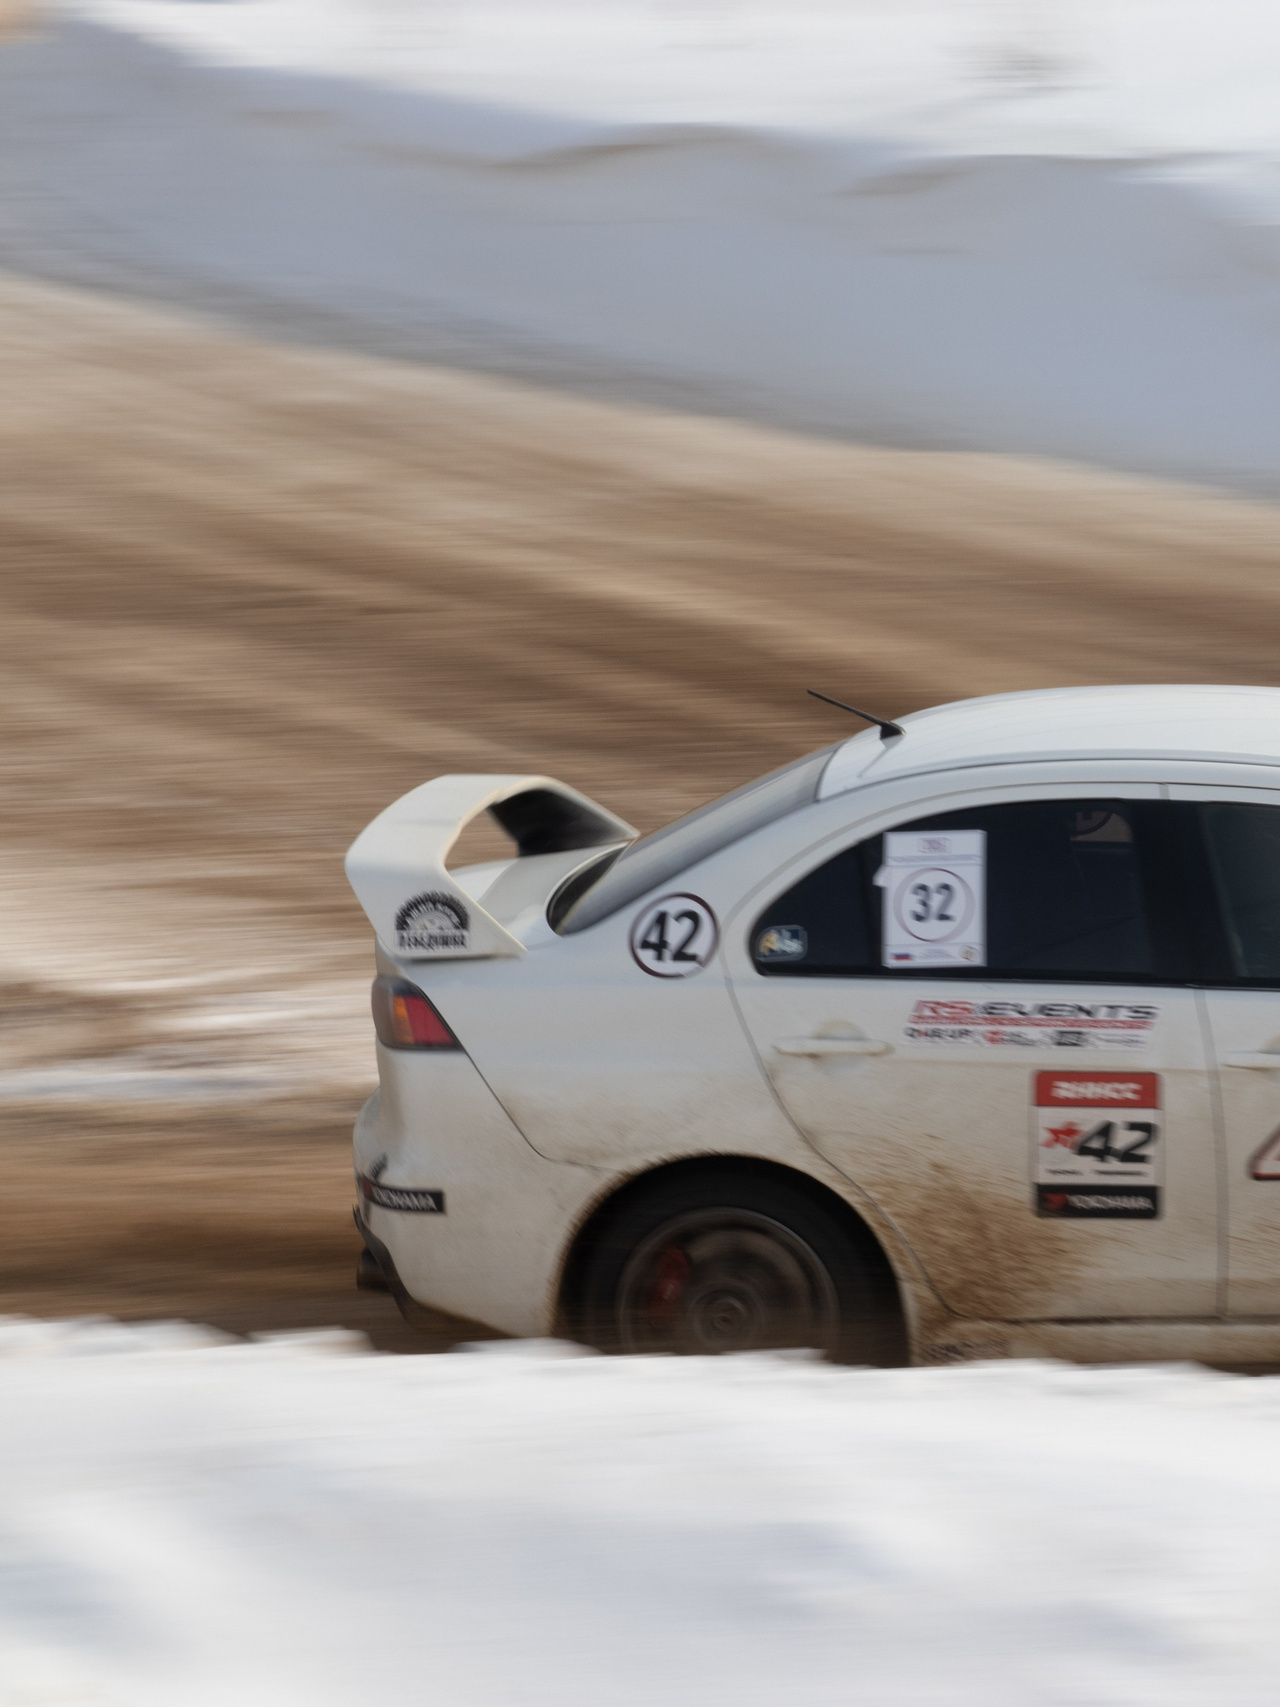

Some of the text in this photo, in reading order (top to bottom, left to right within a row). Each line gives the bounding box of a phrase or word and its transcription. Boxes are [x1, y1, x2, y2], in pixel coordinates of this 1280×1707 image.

[910, 882, 956, 923] 32
[640, 909, 700, 962] 42
[981, 1001, 1161, 1021] EVENTS
[1072, 1119, 1160, 1164] 42
